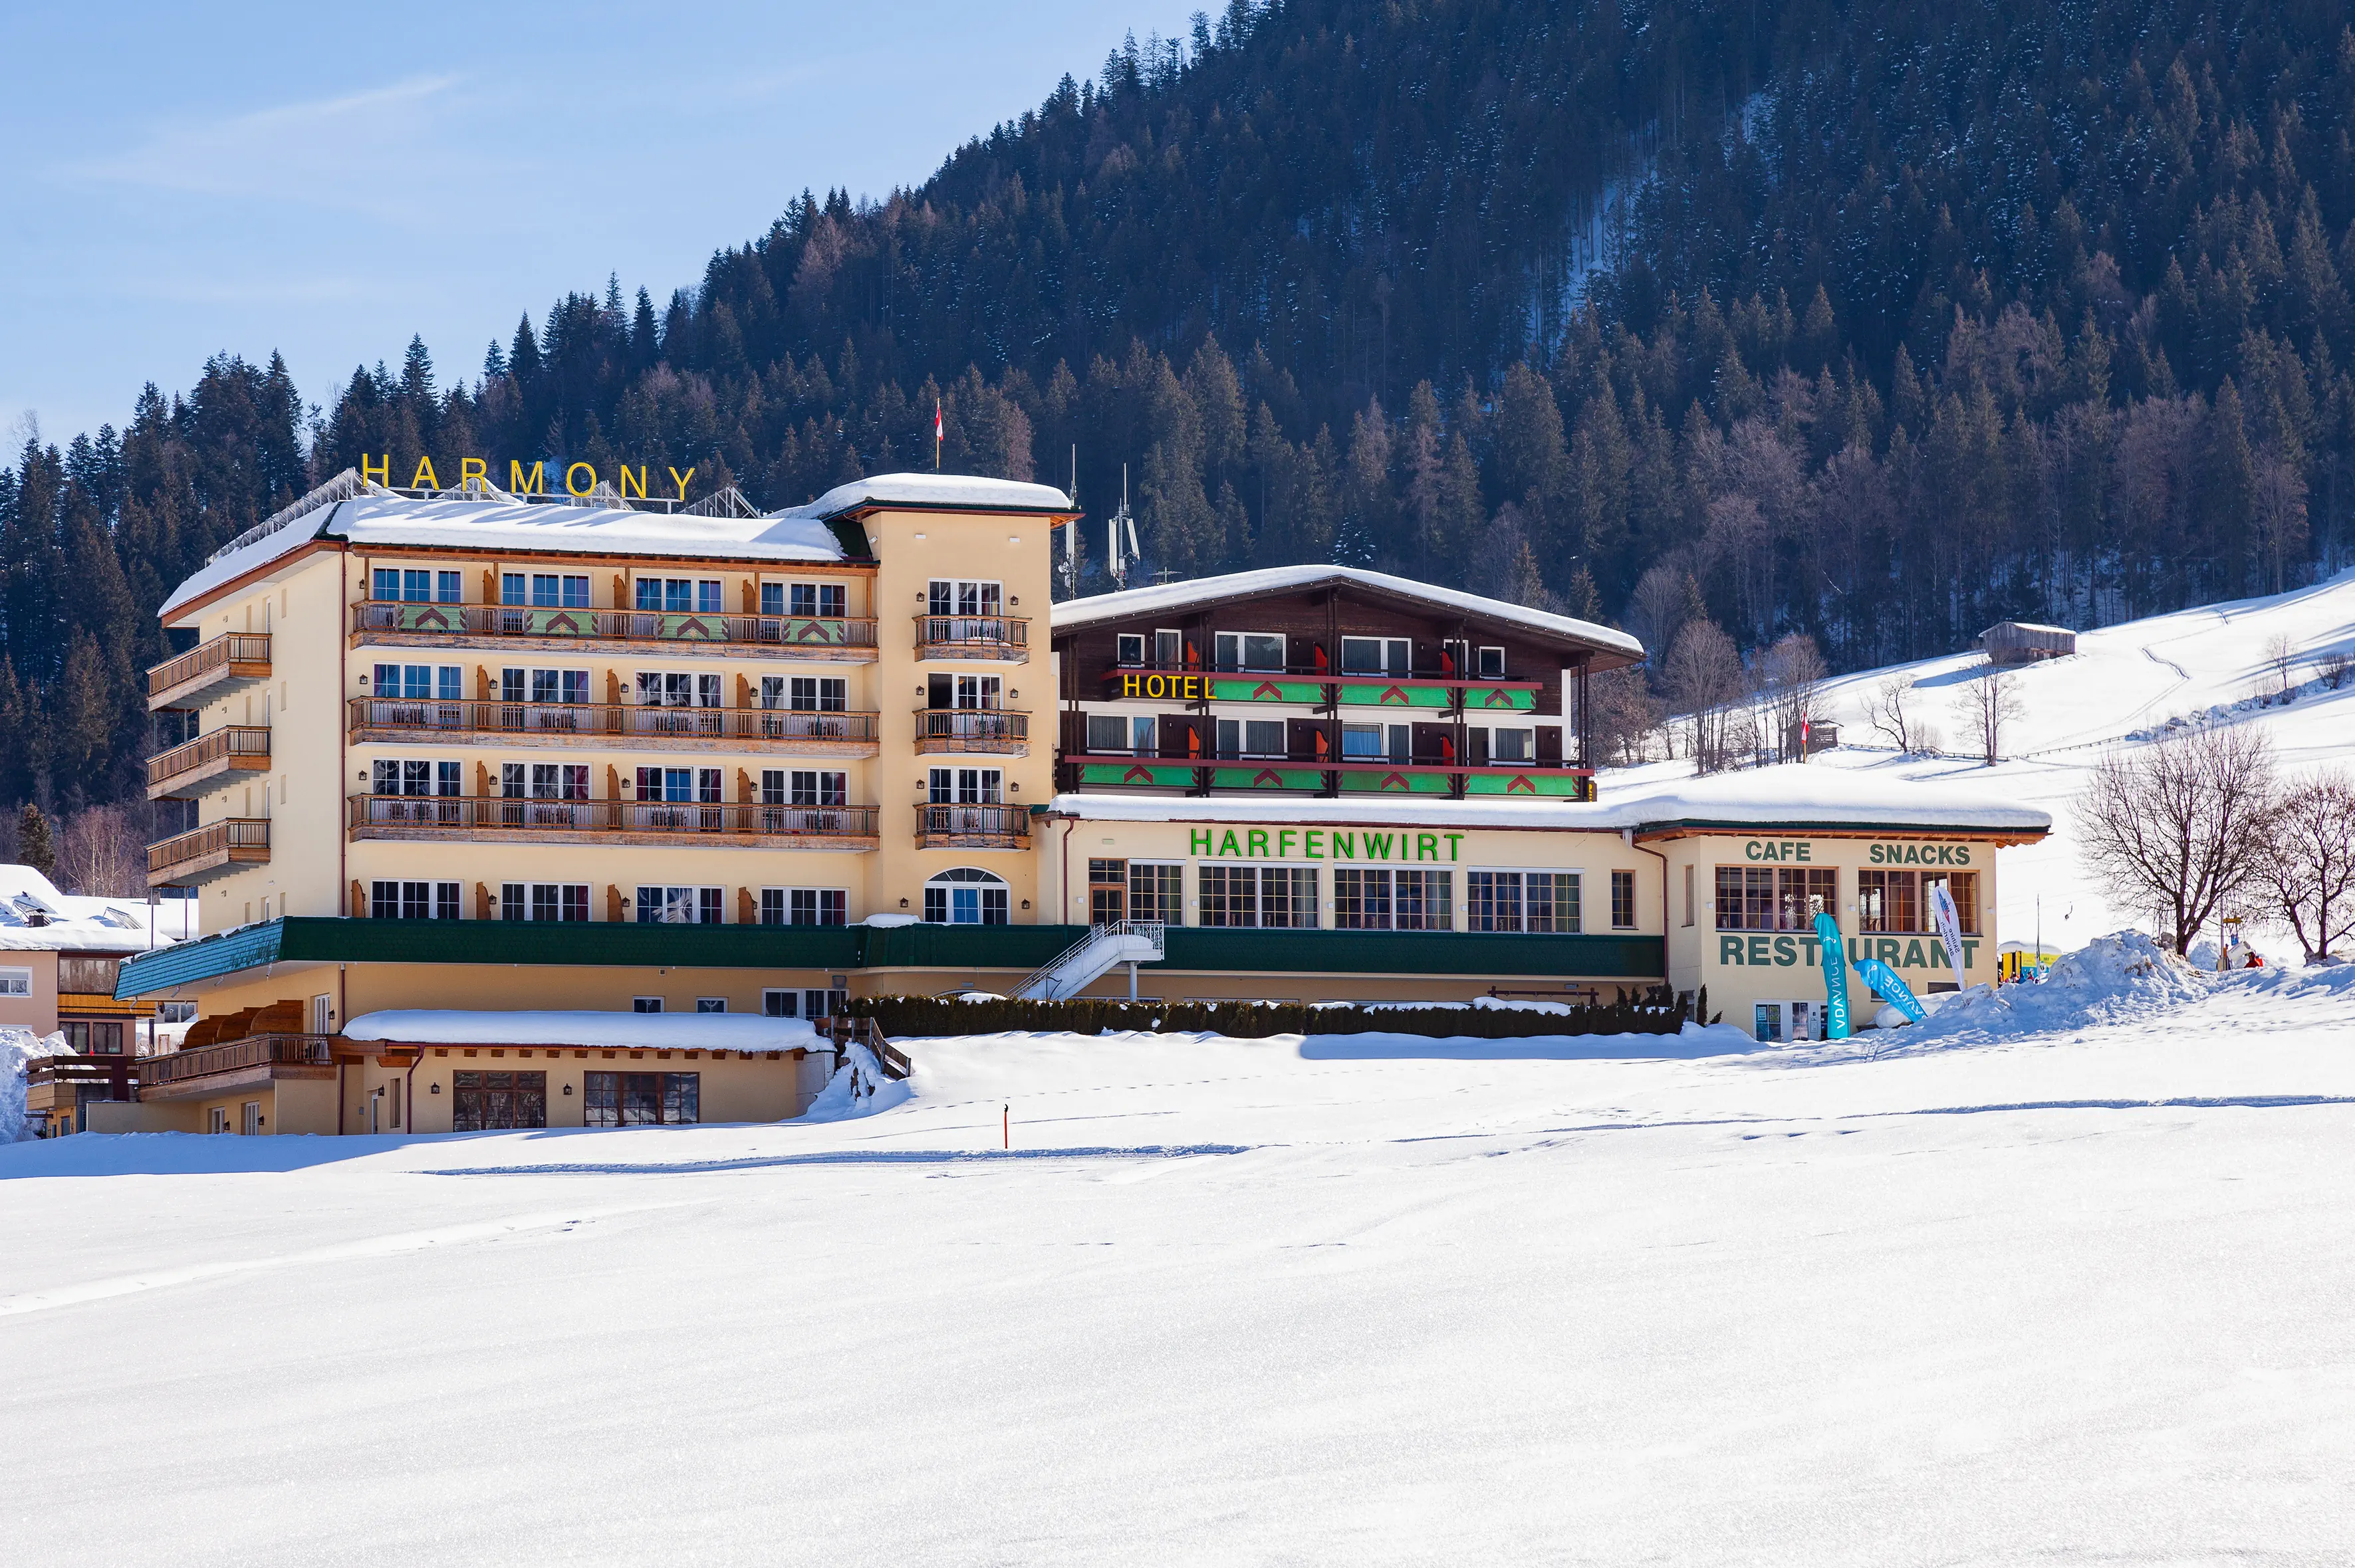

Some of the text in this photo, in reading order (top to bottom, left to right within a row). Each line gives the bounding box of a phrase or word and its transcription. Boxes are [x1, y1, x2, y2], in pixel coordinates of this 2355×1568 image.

[362, 453, 695, 501] HARMONY
[1123, 673, 1217, 700] HOTEL
[1190, 828, 1465, 861] HARFENWIRT
[1745, 840, 1811, 861] CAFE
[1869, 843, 1971, 865] SNACKS
[1720, 935, 1979, 969] RESTURANT
